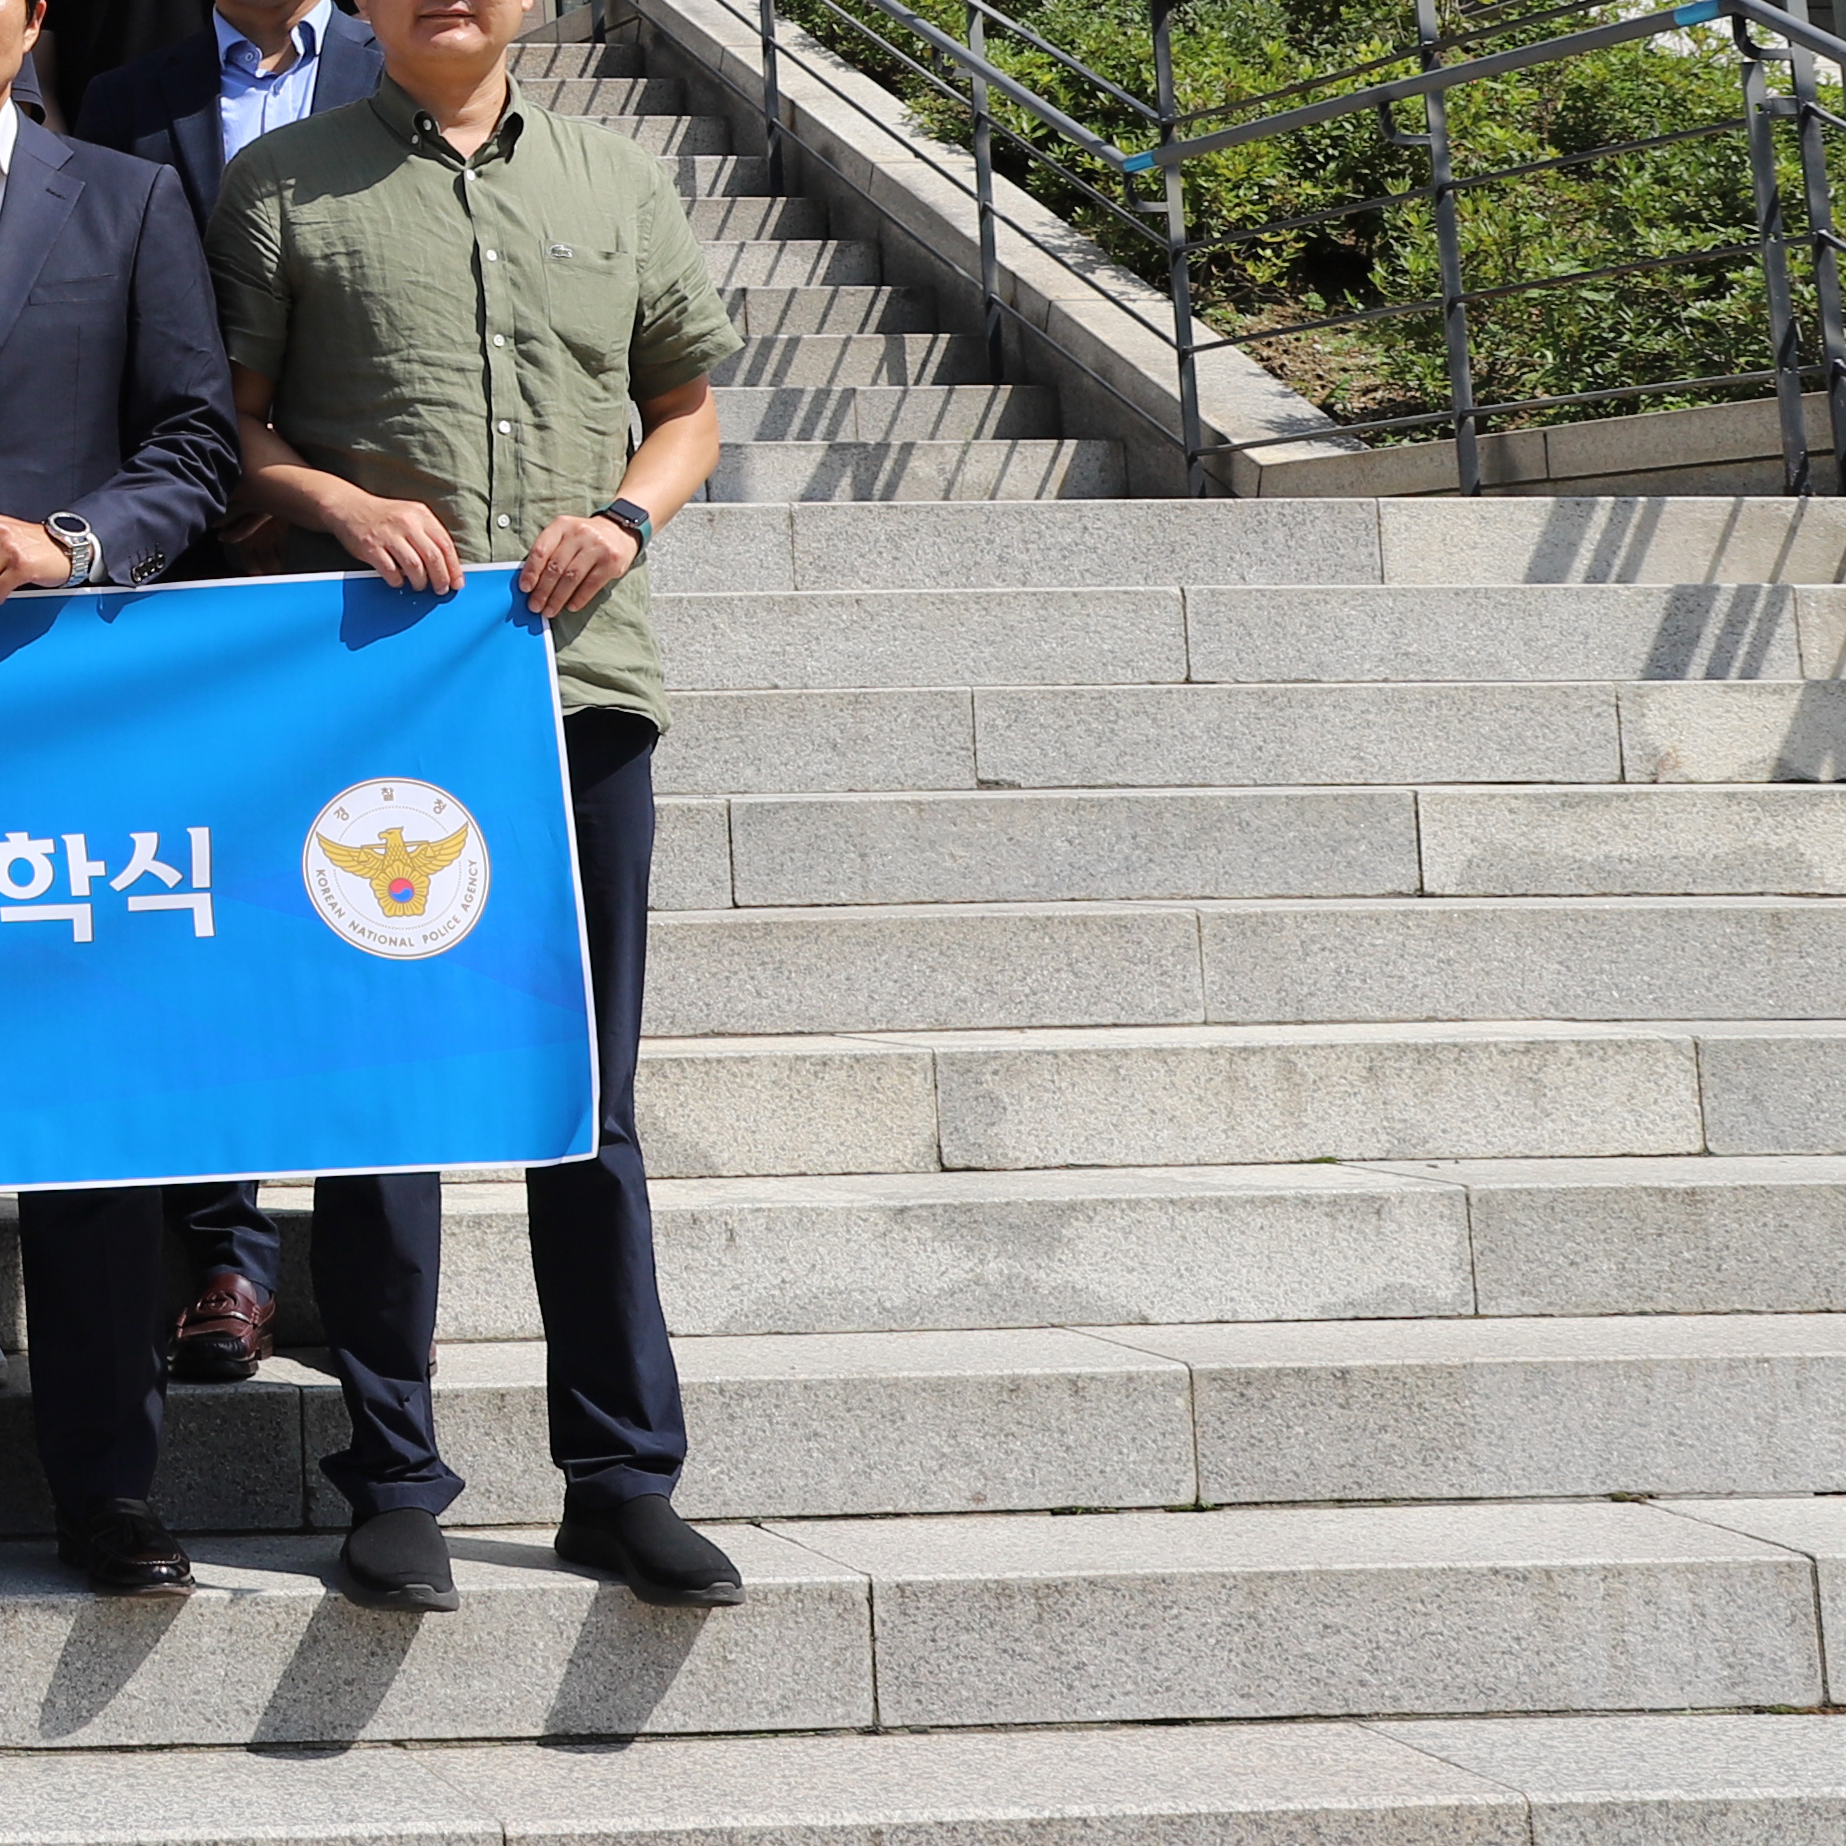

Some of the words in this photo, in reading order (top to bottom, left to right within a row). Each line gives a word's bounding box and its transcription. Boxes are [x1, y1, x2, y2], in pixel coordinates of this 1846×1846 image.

[333, 787, 447, 821] 경찰청
[315, 868, 346, 919] KOREAN
[348, 920, 415, 947] NATIONAL
[422, 915, 461, 944] POLICE
[461, 859, 478, 912] AGENCY
